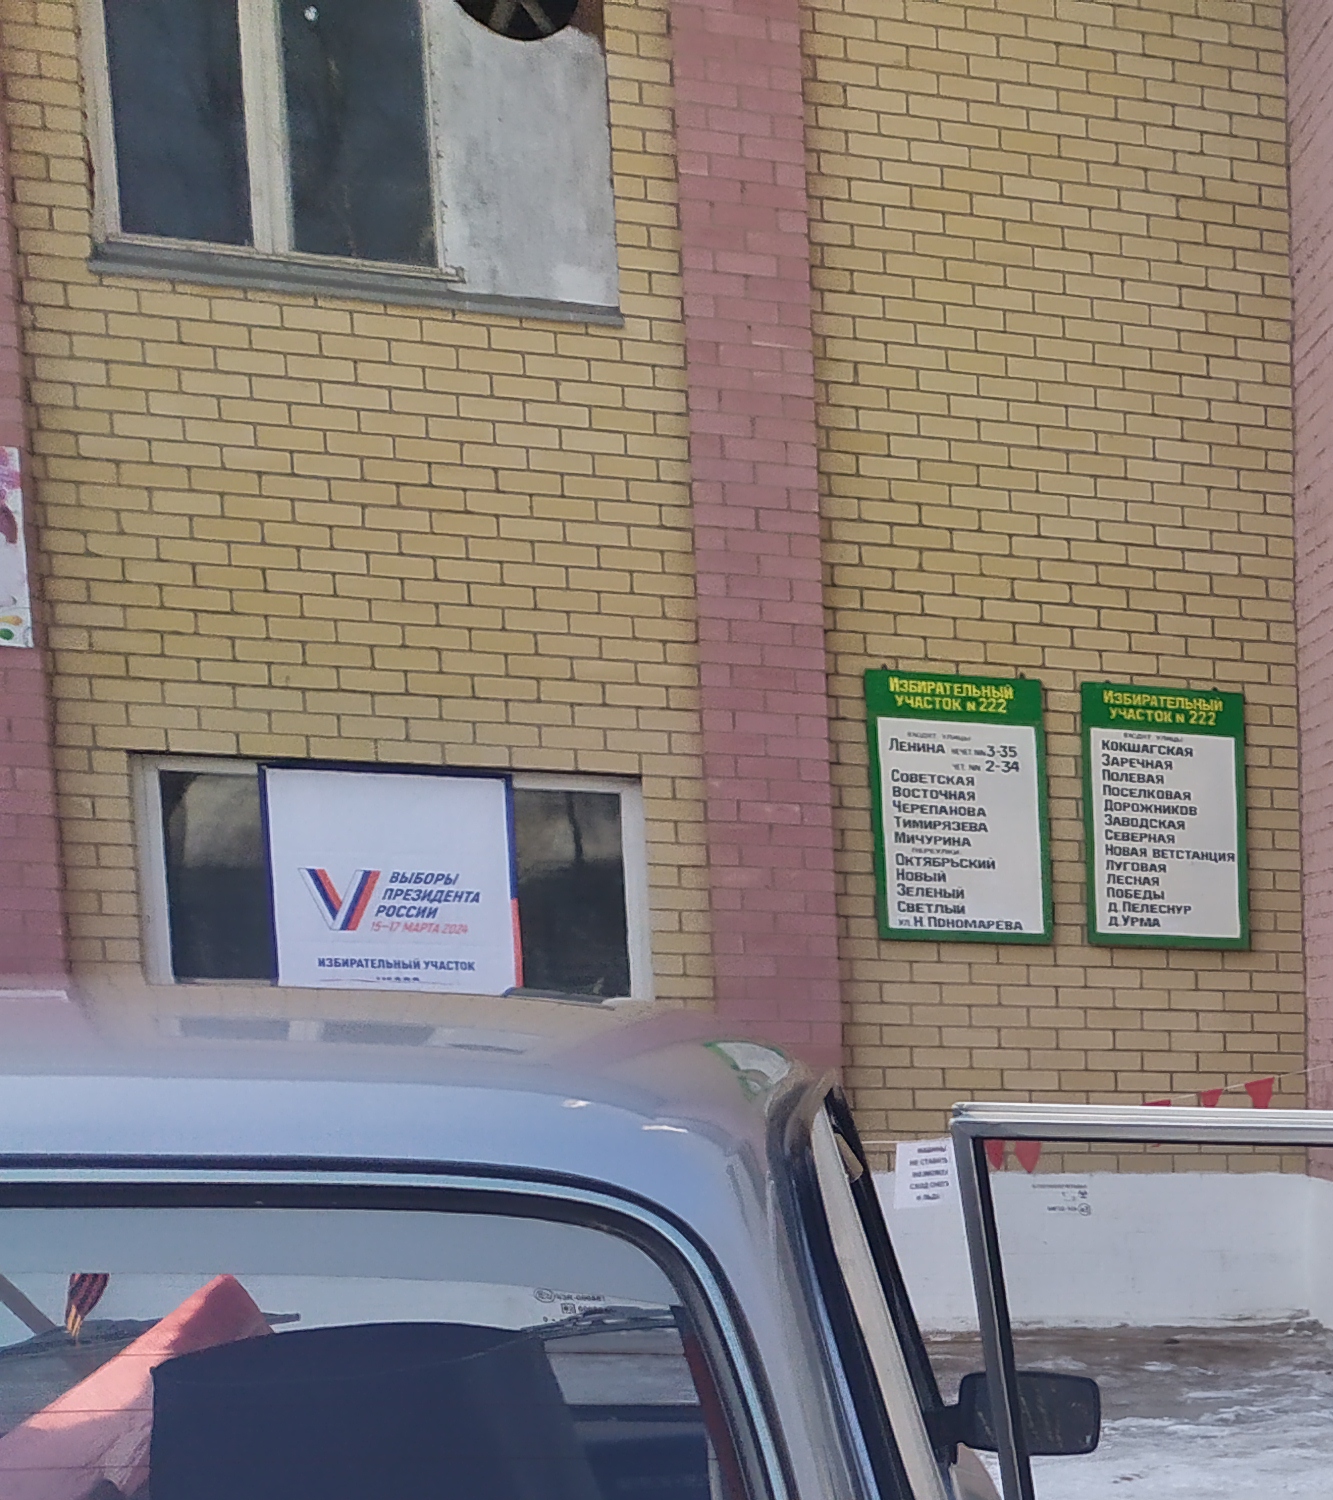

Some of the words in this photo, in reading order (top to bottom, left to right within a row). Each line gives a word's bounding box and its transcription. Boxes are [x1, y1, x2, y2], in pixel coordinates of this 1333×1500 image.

[889, 676, 1014, 700] ИЗБИРАТЕЛЬНЫЙ
[894, 695, 963, 711] УЧАСТОК
[979, 698, 1007, 714] 222
[1103, 690, 1223, 712] ИЗБИРАТЕЛЬНЫЙ
[1109, 707, 1173, 723] УЧАСТОК
[1189, 711, 1216, 726] 222
[889, 738, 946, 755] ЛЕНИНА
[986, 745, 1019, 758] 3-35
[1101, 740, 1194, 757] КОКШАГСКАЯ
[985, 760, 1020, 773] 2-34
[1101, 754, 1173, 770] ЗАРЕЧНАЯ
[891, 768, 975, 787] СОВЕТСКАЯ
[1102, 769, 1164, 784] ПОЛЕВАЯ
[892, 785, 976, 802] ВОСТОЧНАЯ
[1102, 785, 1191, 801] ПОСЕЛКОВАЯ
[893, 800, 987, 817] ЧЕРЕПАНОВА
[1104, 799, 1198, 816] ДОРОЖНИКОВ
[893, 816, 989, 832] ТИМИРЯЗЕВА
[1104, 814, 1186, 830] ЗАВОДСКАЯ
[894, 831, 972, 847] МИЧУРИНА
[1104, 829, 1176, 844] СЕВЕРНАЯ
[895, 853, 996, 869] ОКТЯБРЬСКИЙ
[1105, 844, 1147, 857] НОВАЯ
[1152, 849, 1235, 863] ВЕТСТАНЦИЯ
[1106, 860, 1167, 873] ЛУГОВАЯ
[389, 871, 460, 885] ВЫБОРЫ
[896, 868, 947, 883] НОВЫЙ
[1107, 874, 1160, 886] ЛЕСНАЯ
[381, 888, 480, 904] ПРЕЗИДЕНТА
[1106, 887, 1165, 900] ПОБЕДЫ
[375, 904, 439, 919] РОССИИ
[402, 922, 440, 933] МАРТА
[317, 957, 421, 970] ИЗБИРАТЕЛЬНЫЙ
[423, 961, 476, 971] УЧАСТОК
